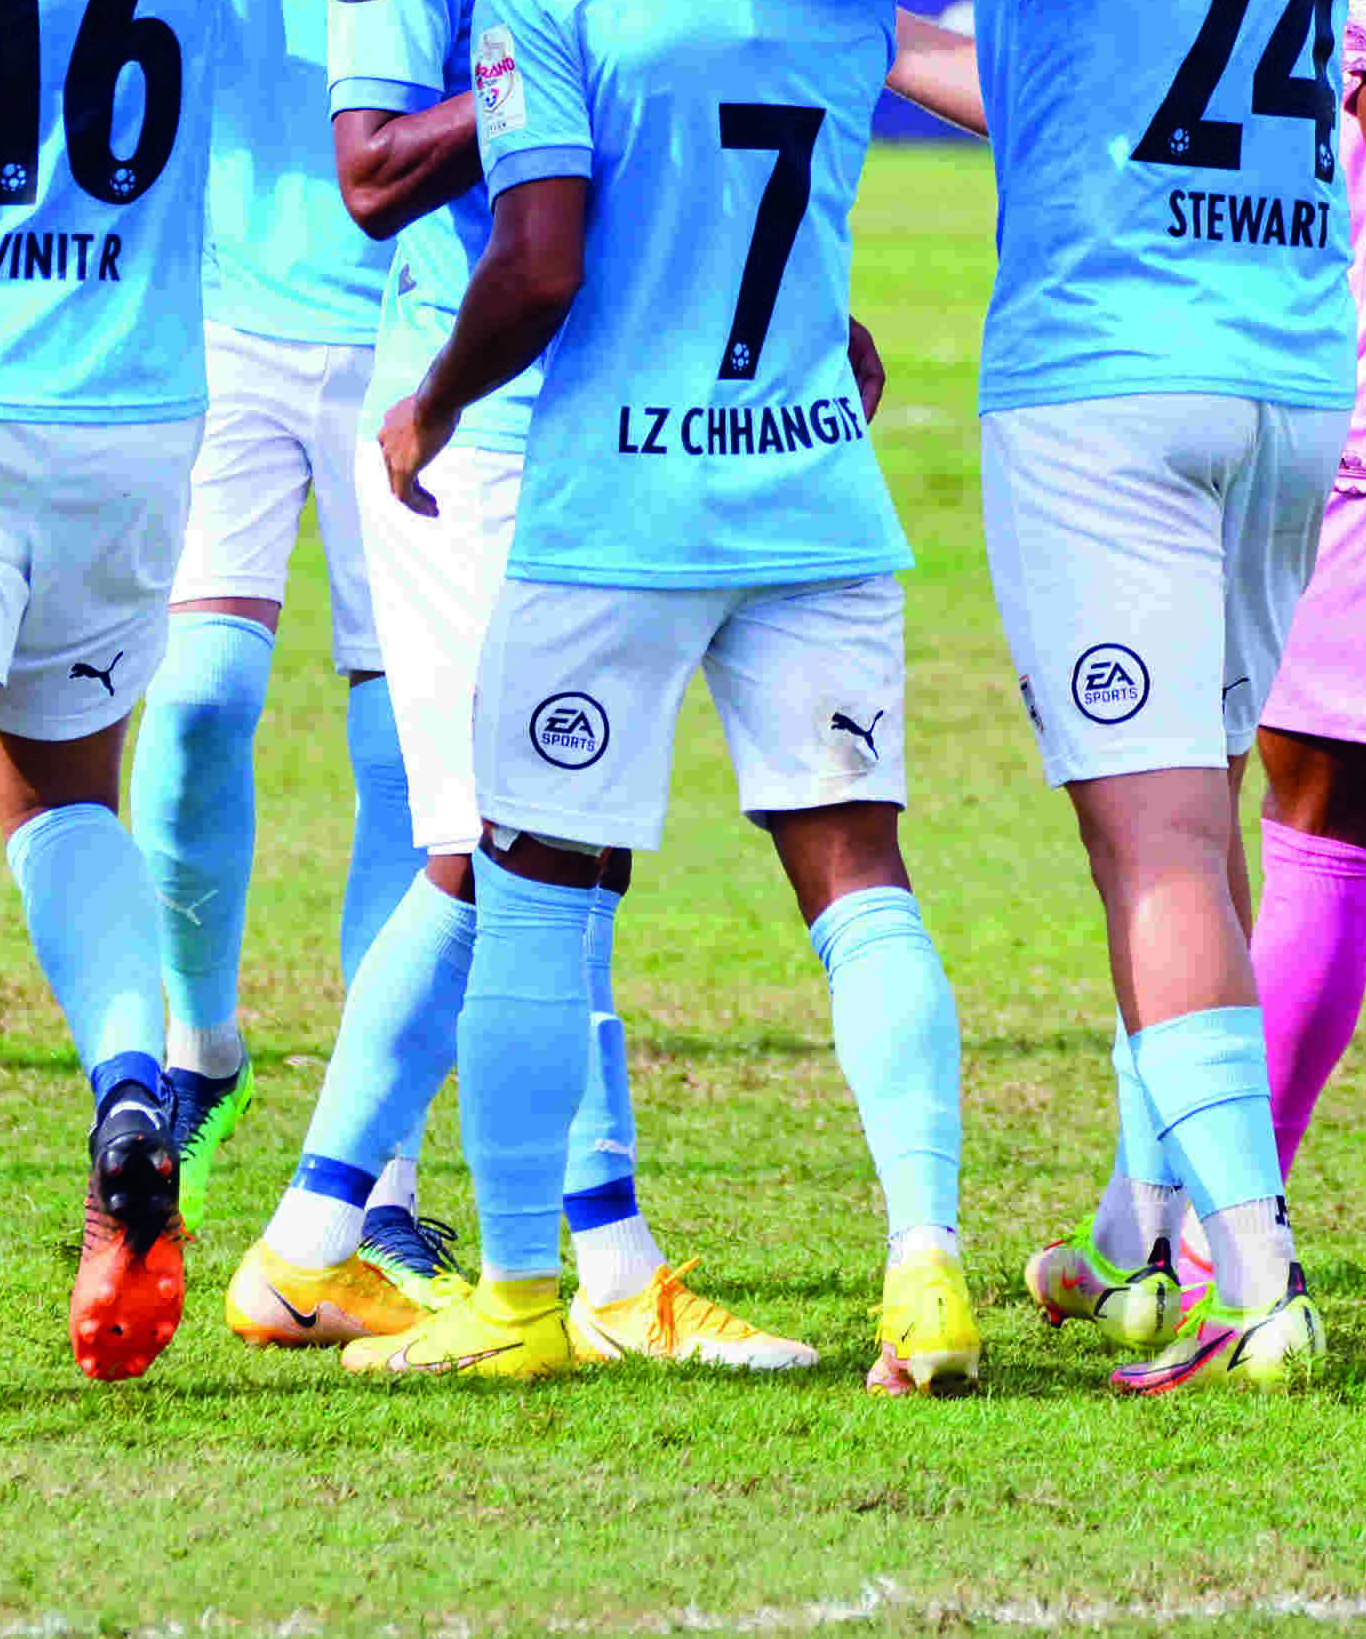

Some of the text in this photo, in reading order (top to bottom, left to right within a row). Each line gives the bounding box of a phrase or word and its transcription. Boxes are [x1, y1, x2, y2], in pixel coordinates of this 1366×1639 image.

[1168, 189, 1330, 249] STEWART
[719, 102, 827, 381] 7
[618, 405, 669, 456] LZ
[1085, 661, 1135, 691] EA
[1084, 686, 1138, 706] SPORTS
[545, 708, 596, 739] EA
[540, 731, 596, 754] SPORTS
